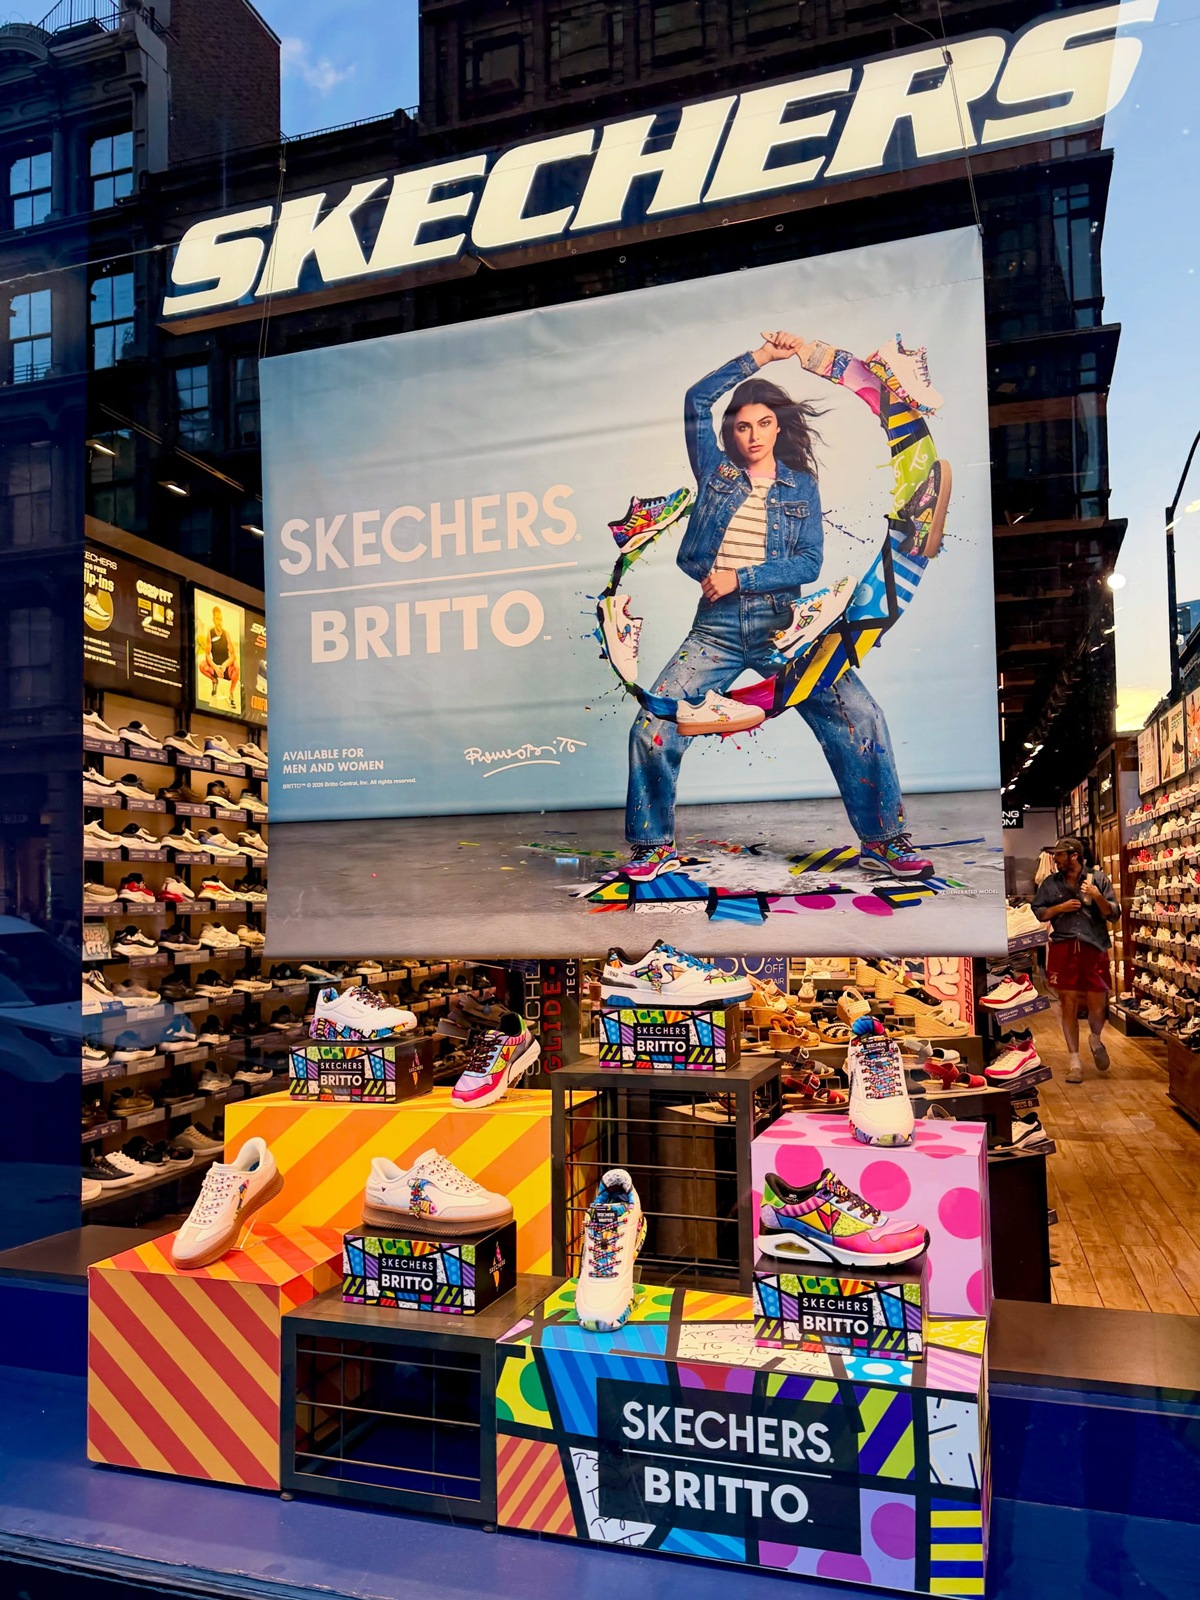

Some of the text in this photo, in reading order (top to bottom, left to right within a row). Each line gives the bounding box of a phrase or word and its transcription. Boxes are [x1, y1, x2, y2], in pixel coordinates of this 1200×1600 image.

[162, 0, 1160, 316] SKECHERS
[282, 748, 364, 761] AVAILABLE FOR
[282, 760, 384, 774] MEN AND WOMEN
[377, 777, 393, 786] rights
[764, 963, 785, 974] OFF
[637, 1026, 687, 1035] SKECHERS
[637, 1040, 686, 1053] BRITTO
[320, 1061, 362, 1070] SKECHERS
[320, 1074, 362, 1086] BRITTO
[381, 1257, 434, 1270] SKECHERS
[381, 1274, 434, 1291] BRITTO
[802, 1297, 869, 1312] SKECHERS
[803, 1315, 869, 1335] BRITTO
